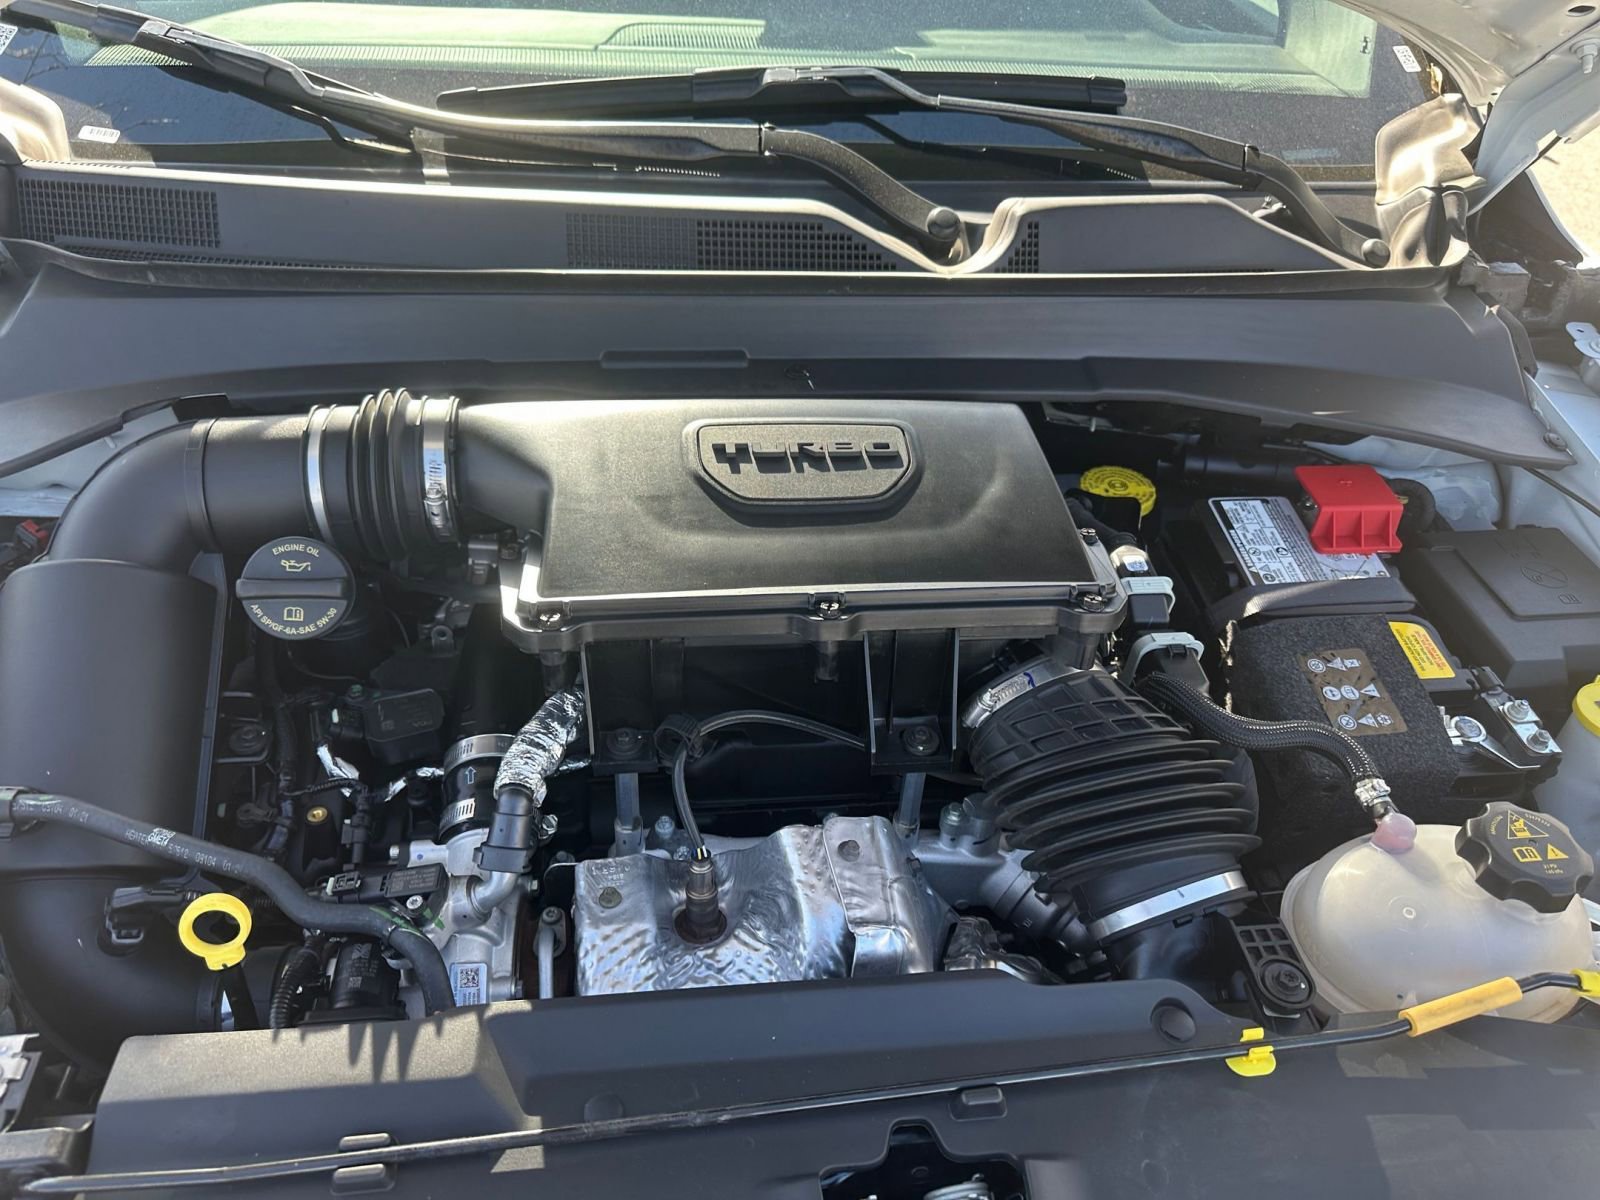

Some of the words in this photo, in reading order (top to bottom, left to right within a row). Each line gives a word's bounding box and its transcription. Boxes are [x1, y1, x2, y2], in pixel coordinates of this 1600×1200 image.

[710, 441, 905, 475] TURBO
[272, 543, 305, 556] ENGINE
[306, 547, 320, 558] OIL
[250, 603, 264, 618] API
[316, 606, 338, 628] 5W-30
